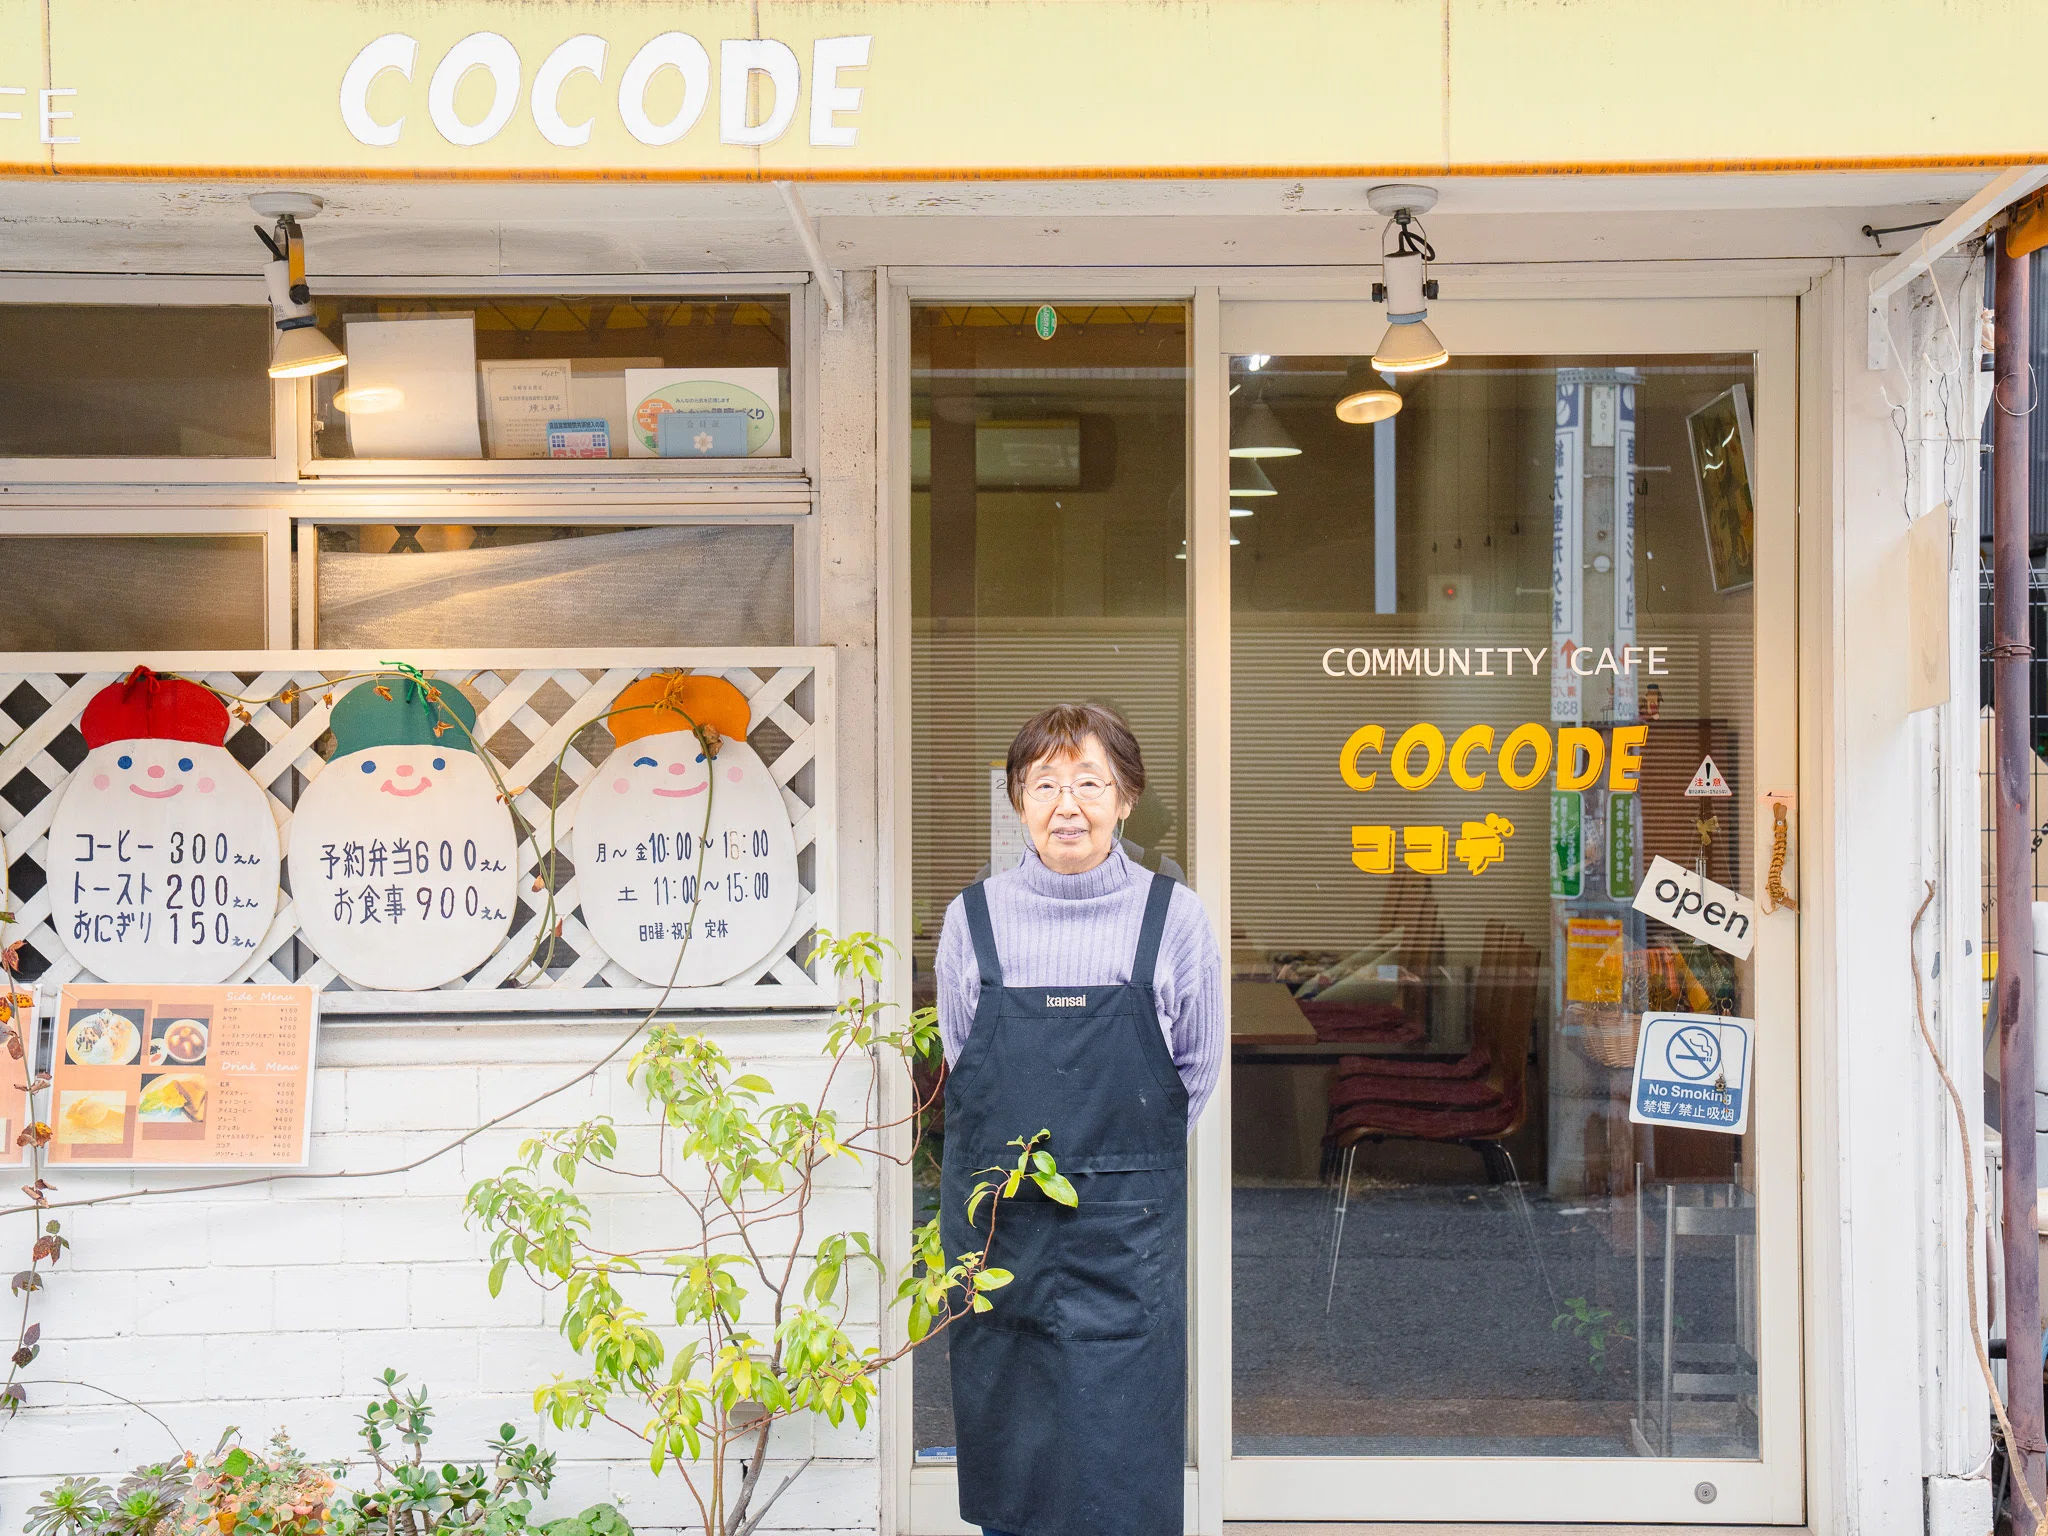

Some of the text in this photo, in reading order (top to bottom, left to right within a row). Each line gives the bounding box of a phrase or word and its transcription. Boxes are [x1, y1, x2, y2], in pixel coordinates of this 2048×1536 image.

[339, 30, 874, 147] COCODE
[1322, 647, 1548, 677] COMMUNITY
[1570, 646, 1669, 676] CAFE
[1339, 722, 1648, 791] COCODE
[75, 826, 154, 862] コーヒー
[74, 871, 153, 905] トースト
[617, 886, 648, 902] 土
[334, 884, 406, 925] お食事
[1654, 878, 1750, 940] open
[74, 911, 152, 943] おにぎり
[704, 918, 729, 938] 定休
[226, 991, 296, 1001] Side Menu
[1046, 994, 1087, 1008] kansai
[221, 1061, 301, 1072] Drink Menu
[1648, 1083, 1733, 1106] No Smoking
